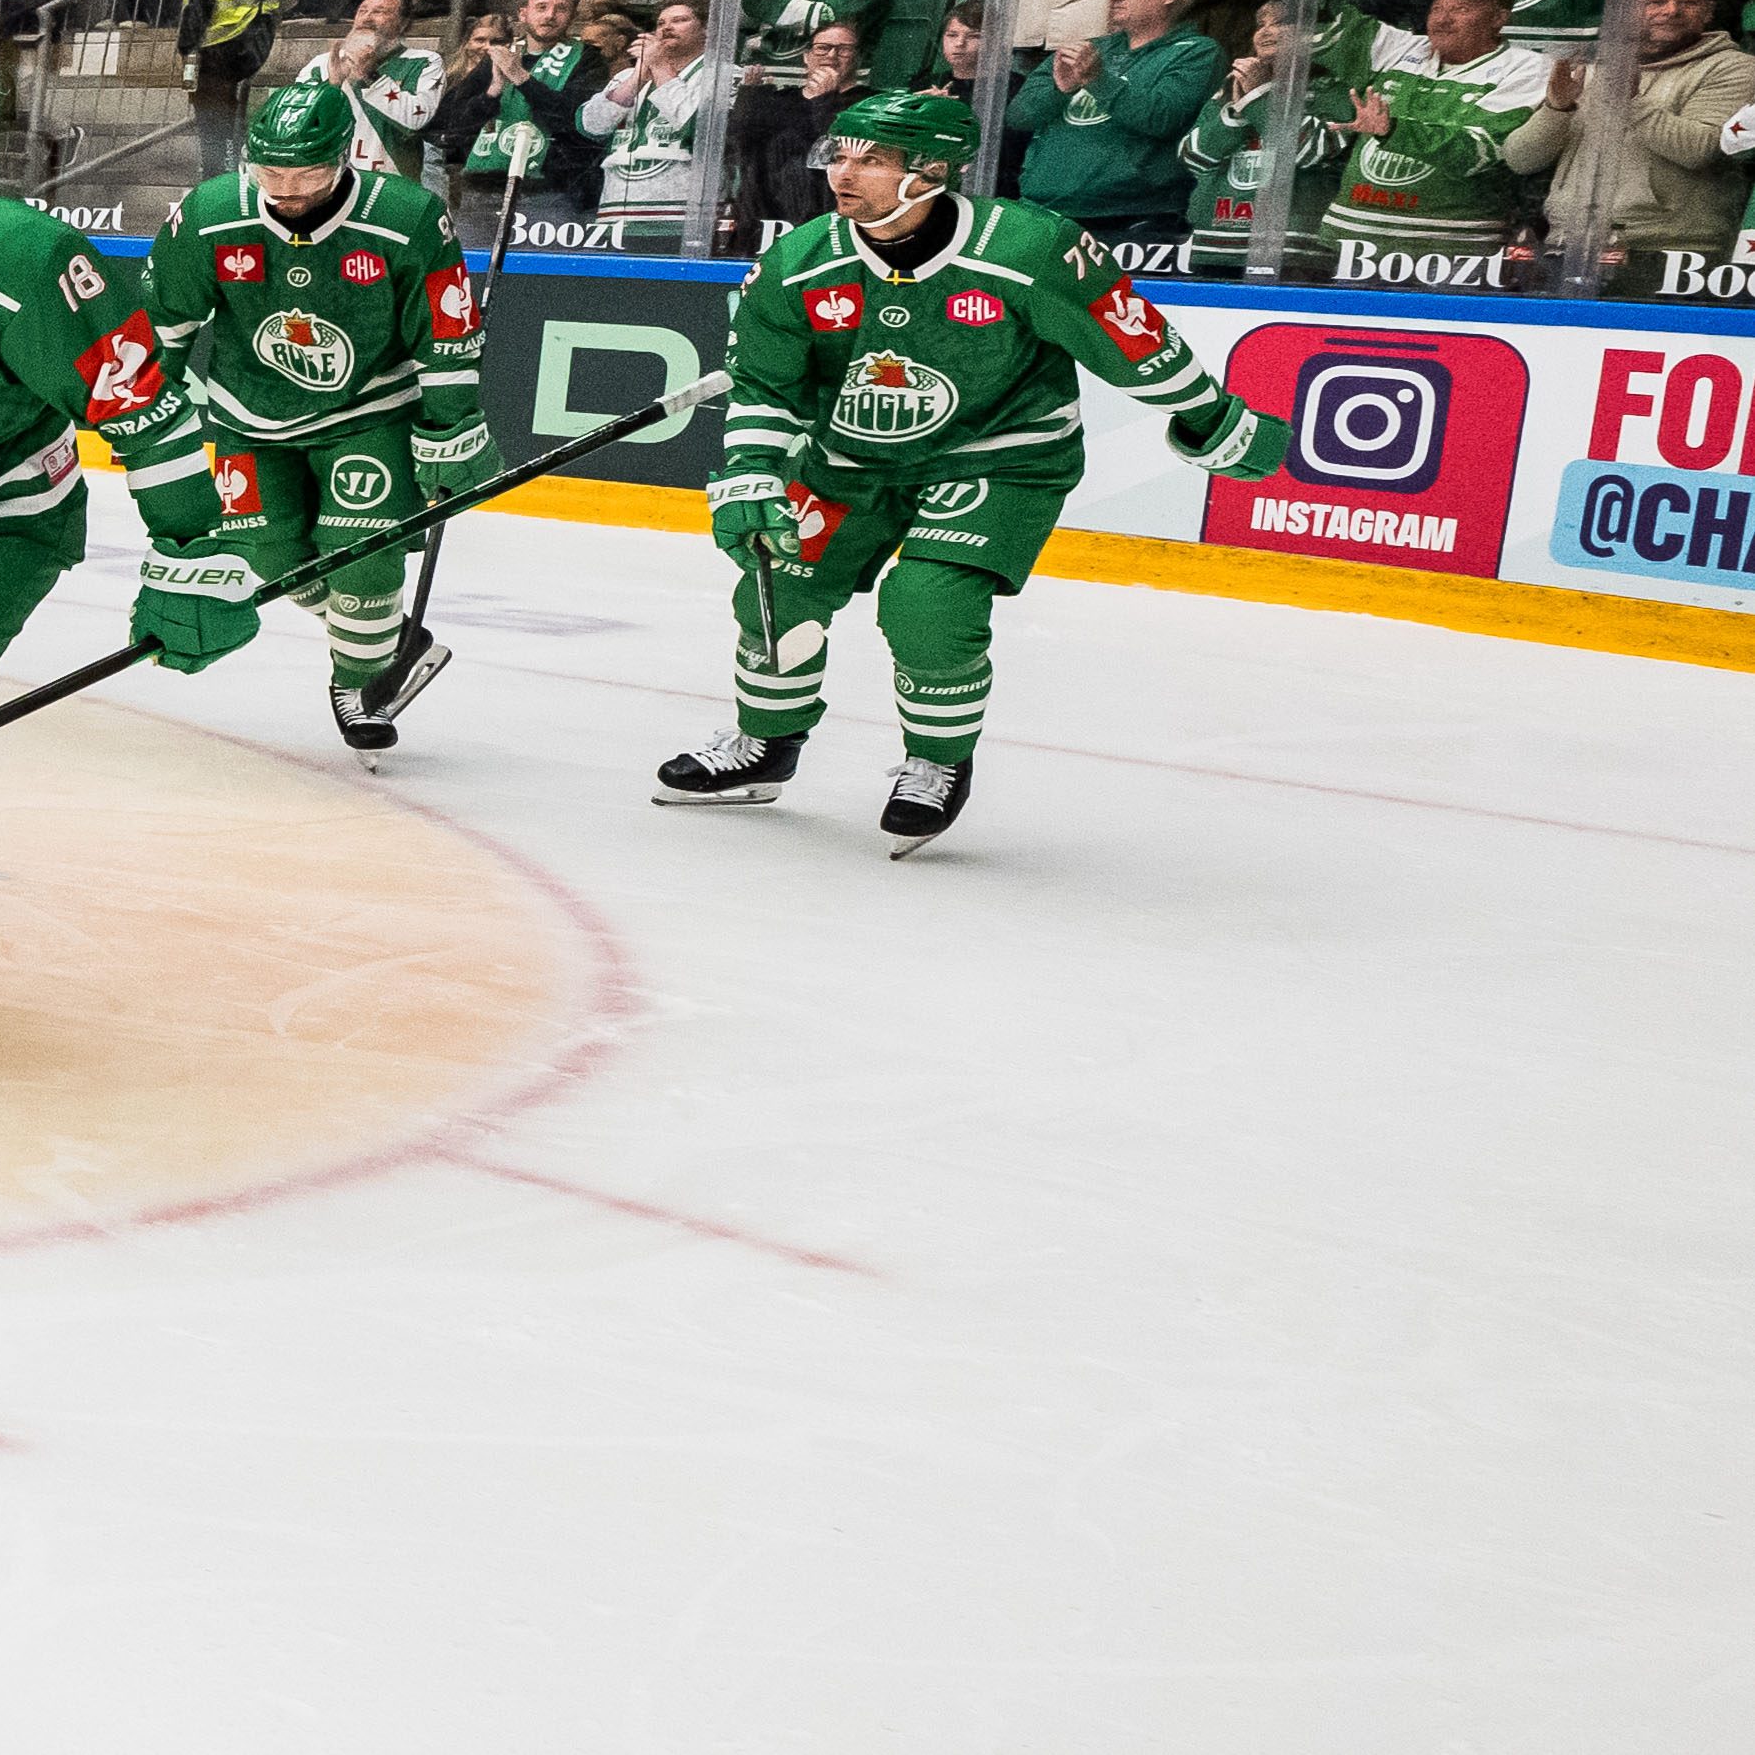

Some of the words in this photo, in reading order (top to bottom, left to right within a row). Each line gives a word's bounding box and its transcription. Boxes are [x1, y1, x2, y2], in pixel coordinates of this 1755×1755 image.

[345, 255, 381, 280] CHL
[1063, 232, 1108, 281] 72
[1332, 237, 1510, 289] Boozt
[57, 253, 107, 314] 18
[953, 295, 997, 323] CHL
[102, 389, 184, 437] STRAUSS
[840, 388, 935, 432] RÖGLE
[1250, 496, 1458, 553] INSTAGRAM
[140, 561, 246, 587] BAUER
